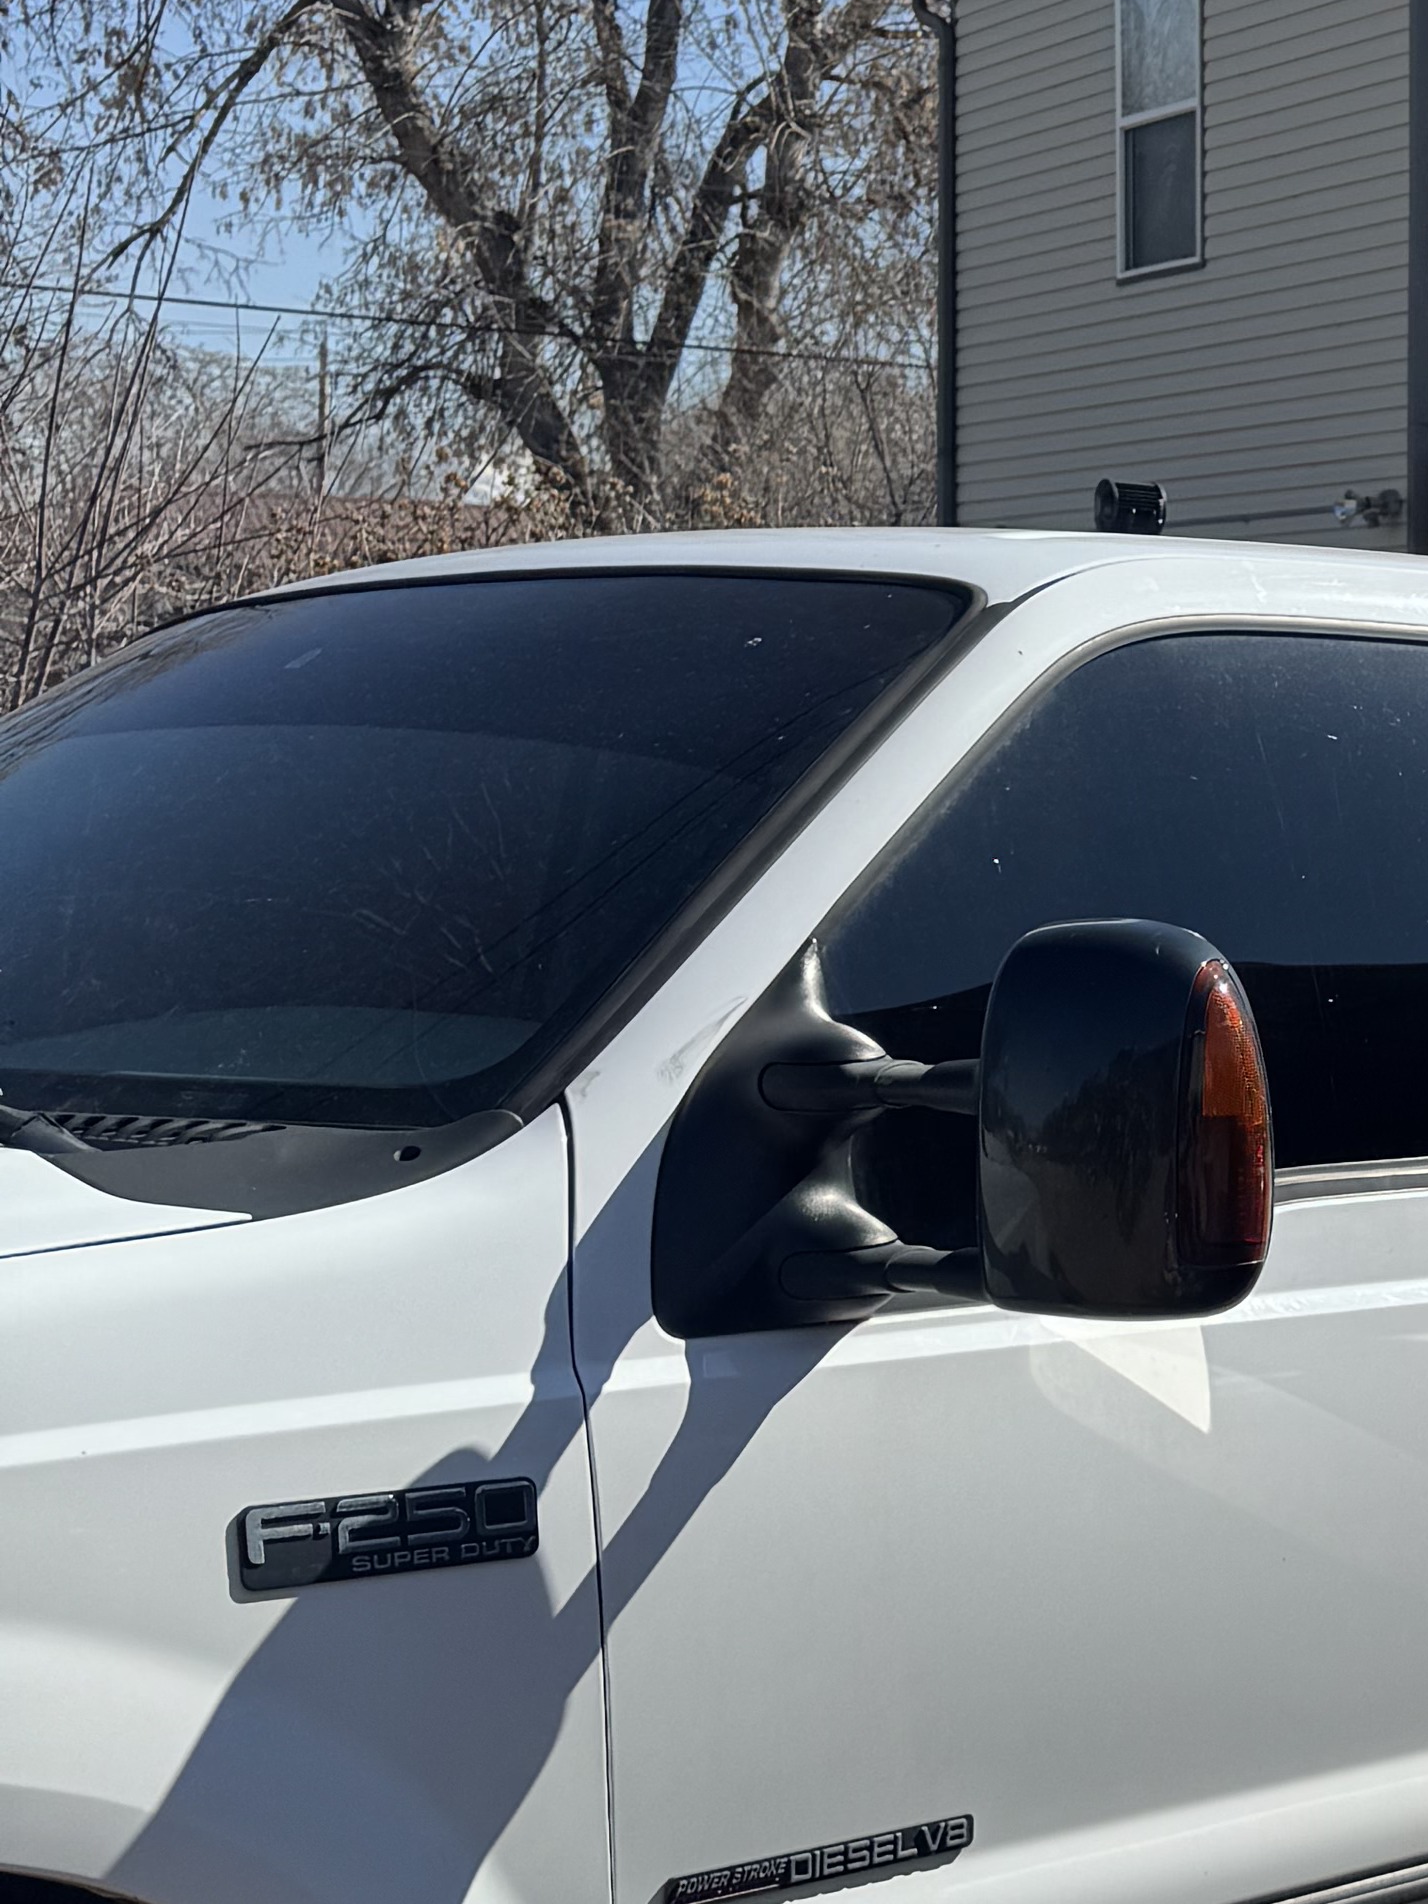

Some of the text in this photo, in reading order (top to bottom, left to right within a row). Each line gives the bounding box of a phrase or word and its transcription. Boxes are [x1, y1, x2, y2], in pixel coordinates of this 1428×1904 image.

[352, 1536, 537, 1573] SUPER DUTY
[677, 1817, 968, 1897] POWER STROKE DIESEL V8
